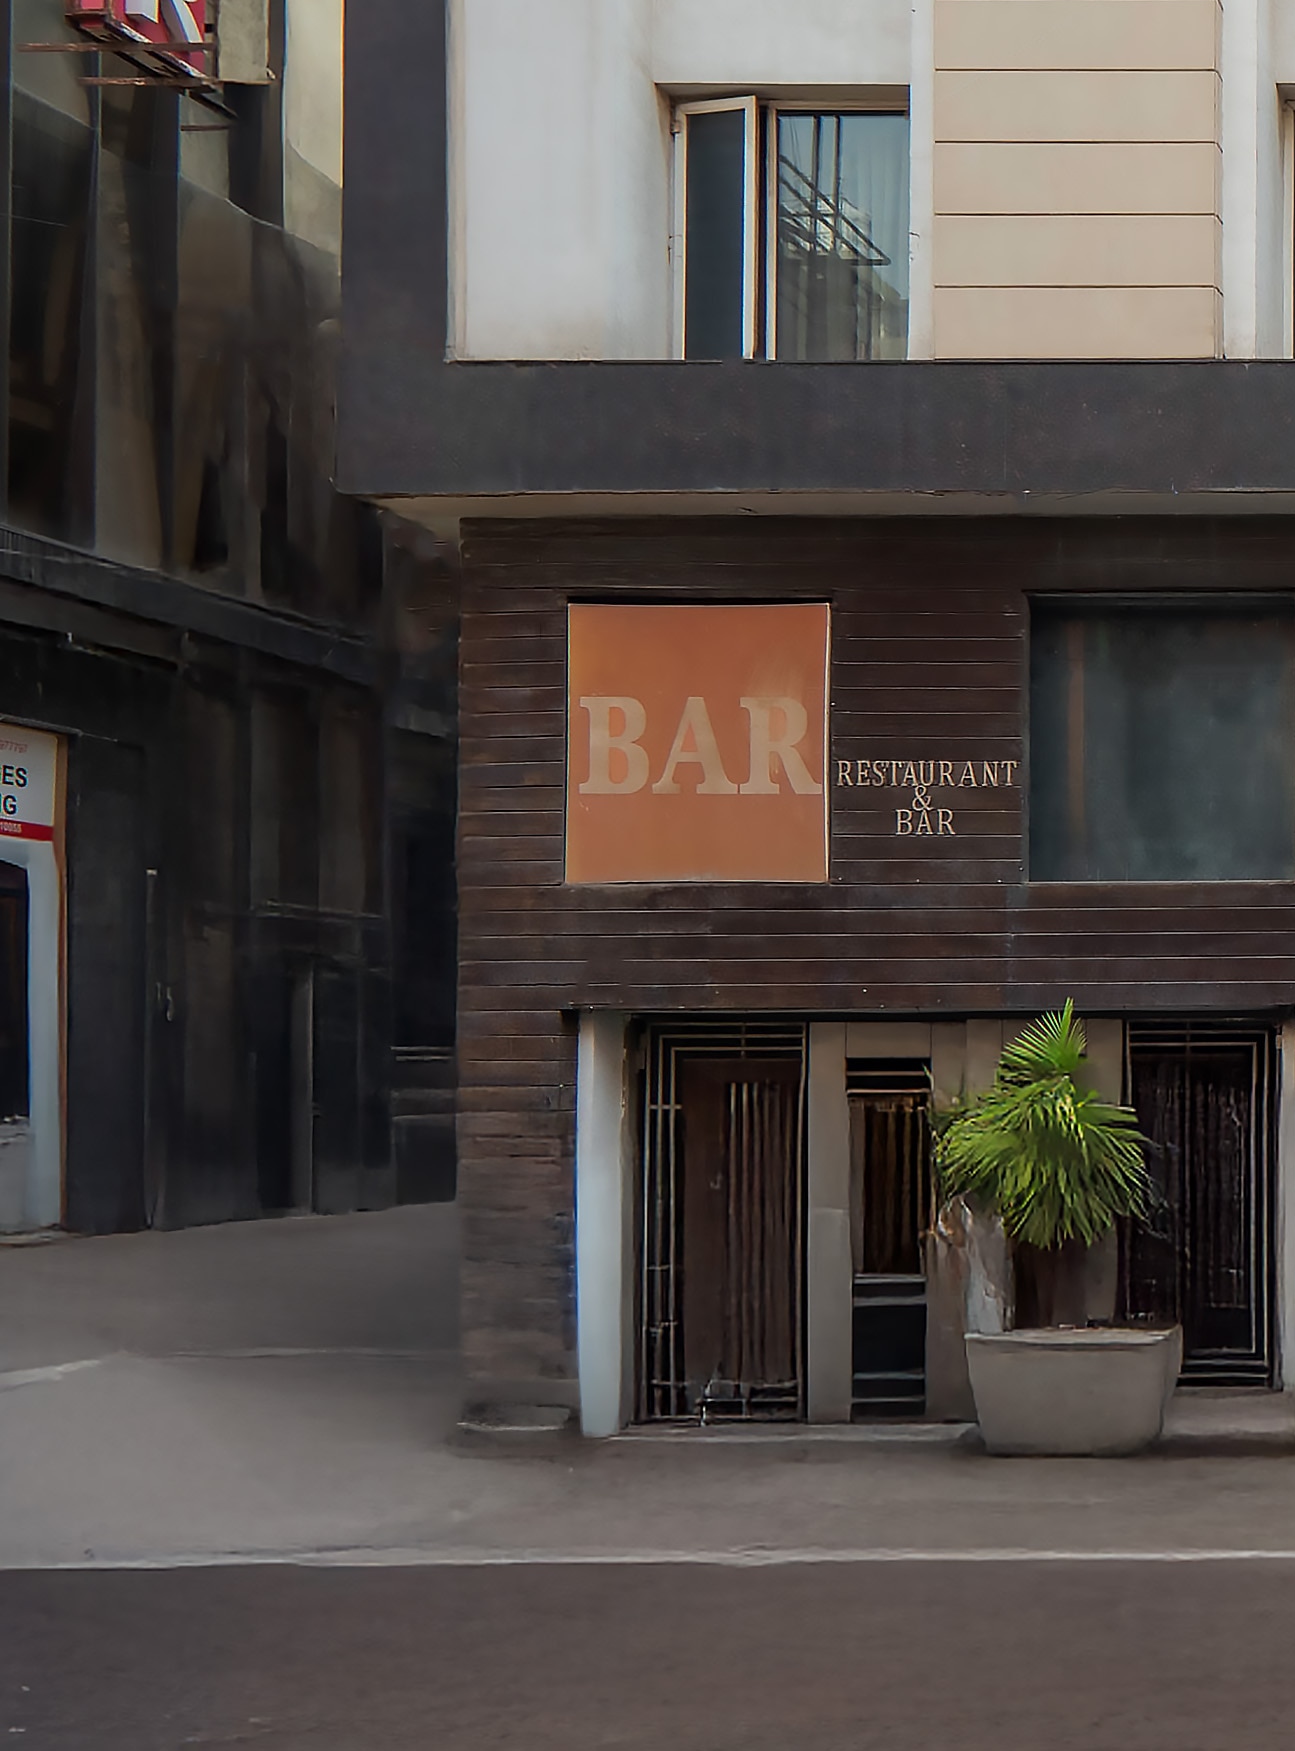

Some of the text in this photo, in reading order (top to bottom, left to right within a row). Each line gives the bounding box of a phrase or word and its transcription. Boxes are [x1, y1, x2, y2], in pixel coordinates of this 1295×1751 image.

[579, 696, 823, 795] BAR
[0, 764, 28, 788] ES
[836, 759, 1019, 788] RESTAURANT
[911, 784, 933, 812] &
[895, 809, 956, 836] BAR
